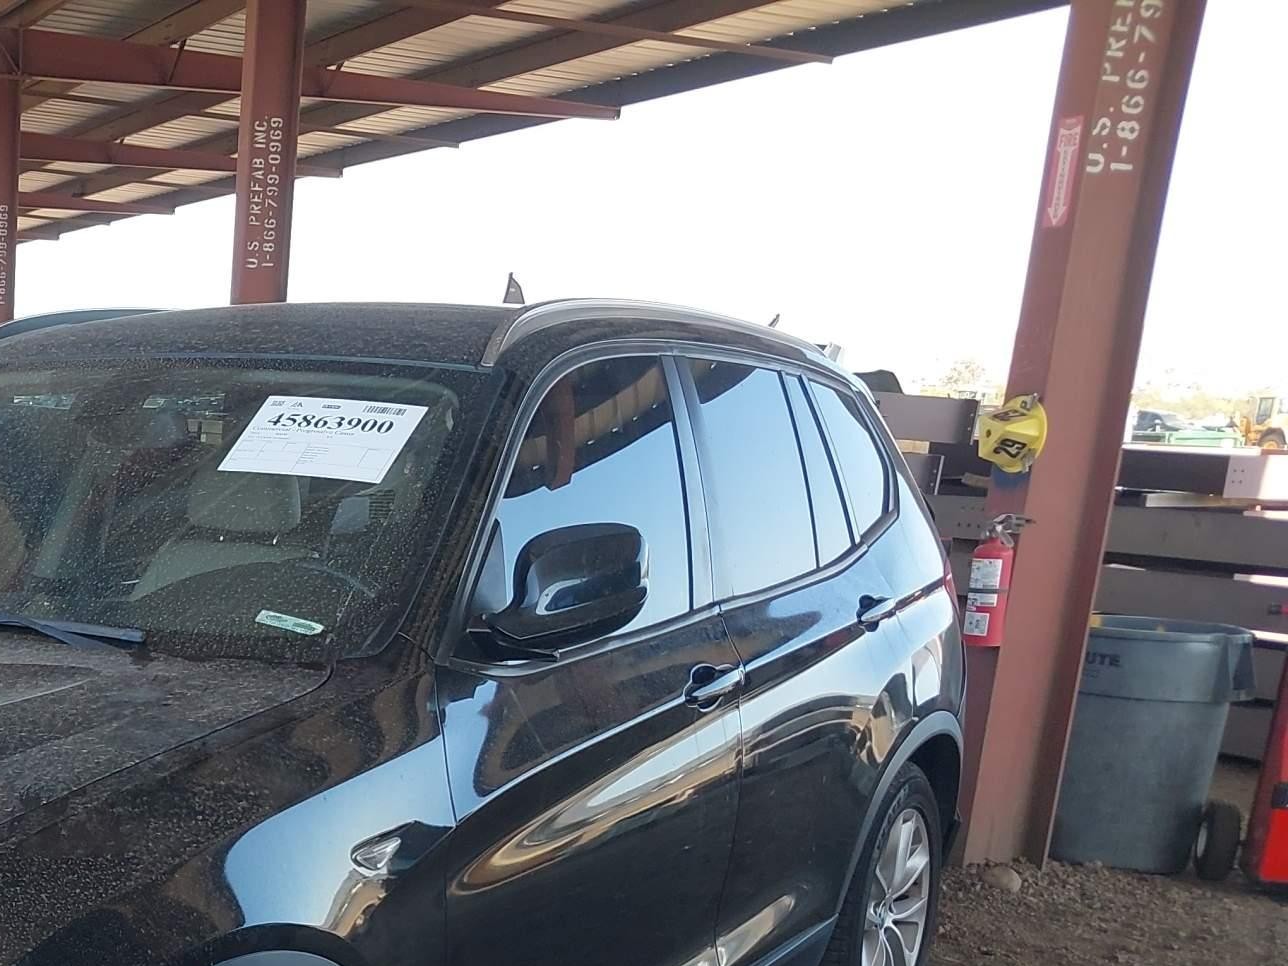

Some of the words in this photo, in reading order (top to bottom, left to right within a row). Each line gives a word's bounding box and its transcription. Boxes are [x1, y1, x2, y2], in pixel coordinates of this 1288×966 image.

[1086, 106, 1115, 173] U.S.
[248, 158, 265, 225] PREFAB
[261, 117, 284, 268] 1-866-799-0969
[267, 412, 395, 435] 45863900
[1086, 651, 1122, 668] UTE
